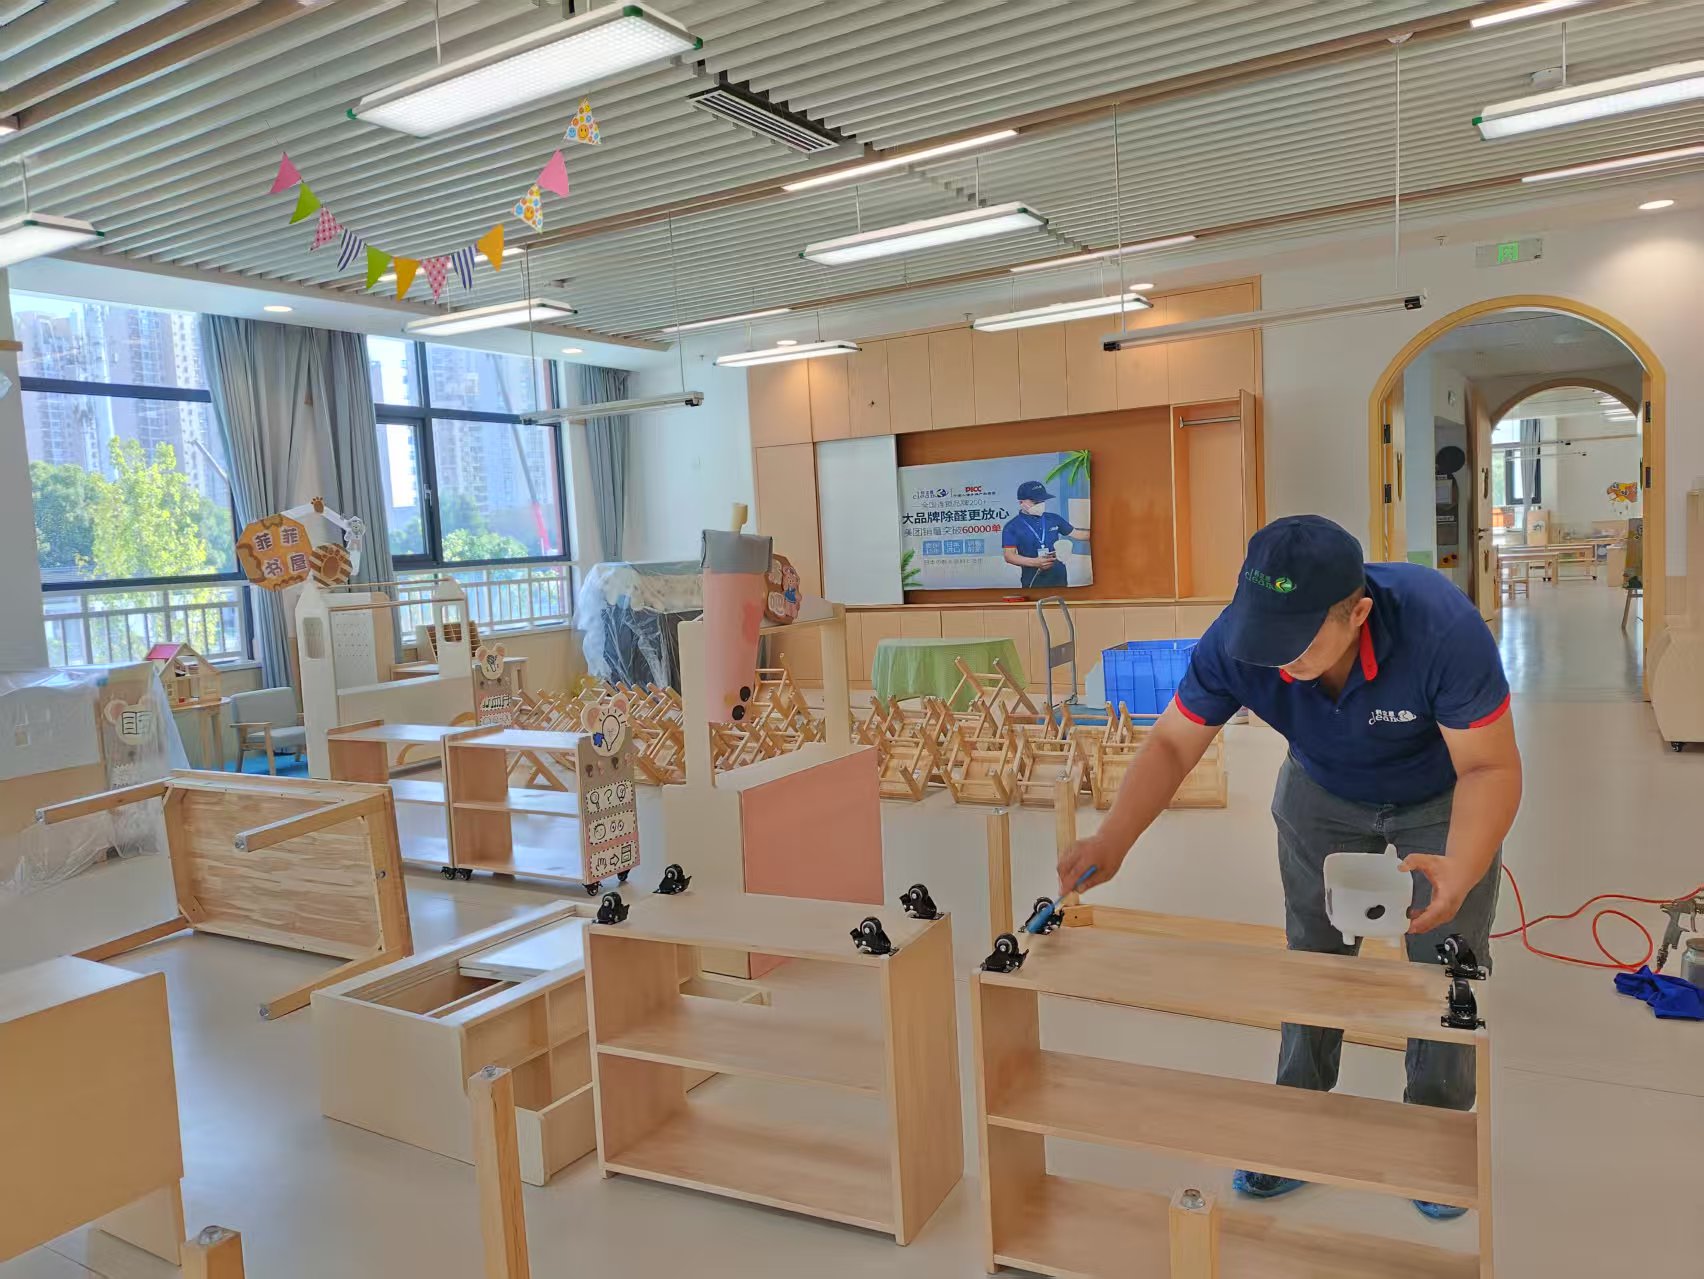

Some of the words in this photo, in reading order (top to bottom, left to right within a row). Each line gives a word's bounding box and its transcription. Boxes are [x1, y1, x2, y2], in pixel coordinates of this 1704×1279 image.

[902, 507, 1010, 525] 大品牌除醛更放心
[255, 527, 299, 551] 菲菲
[265, 553, 307, 577] 书屋
